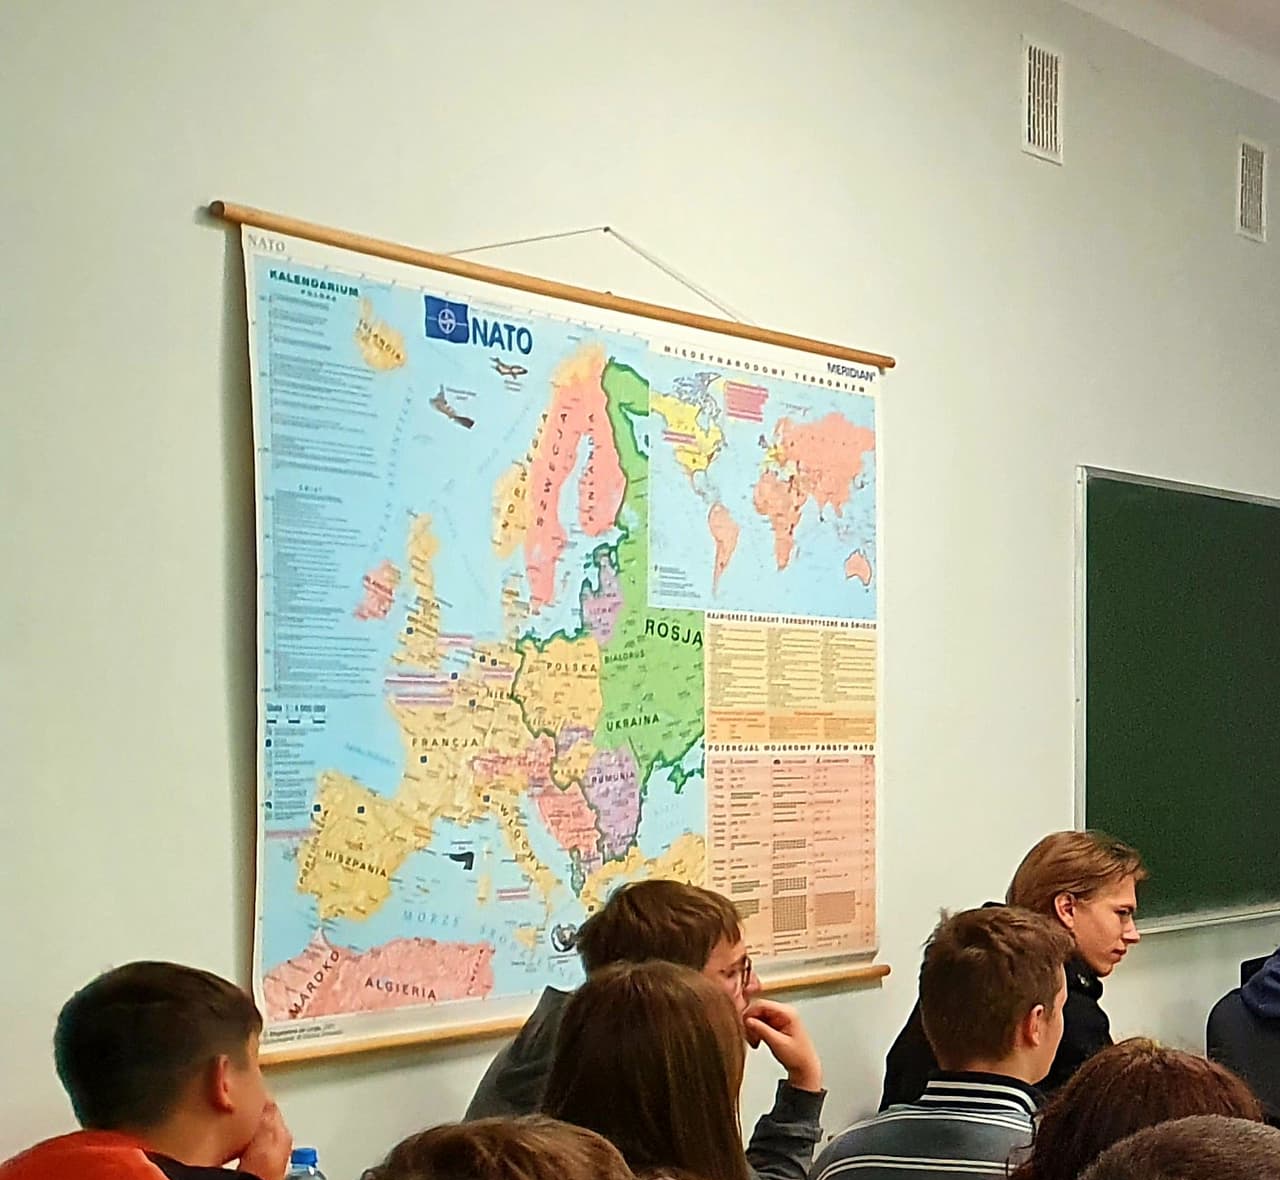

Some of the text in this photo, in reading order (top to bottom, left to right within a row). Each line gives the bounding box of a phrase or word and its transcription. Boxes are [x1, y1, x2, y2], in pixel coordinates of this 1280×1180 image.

[247, 233, 286, 252] NATO
[269, 269, 360, 297] KALENDARIUM
[471, 316, 533, 355] NATO
[536, 412, 568, 528] SZWECJA
[644, 618, 704, 648] ROSJA
[546, 662, 598, 673] POLSKA
[606, 713, 660, 732] UKRAINA
[411, 737, 479, 748] FRANCJA
[591, 772, 635, 784] RUMUNIA
[325, 850, 388, 878] HISZPANIA
[289, 950, 340, 1019] MAROKO
[364, 977, 437, 1000] ALGIERIA
